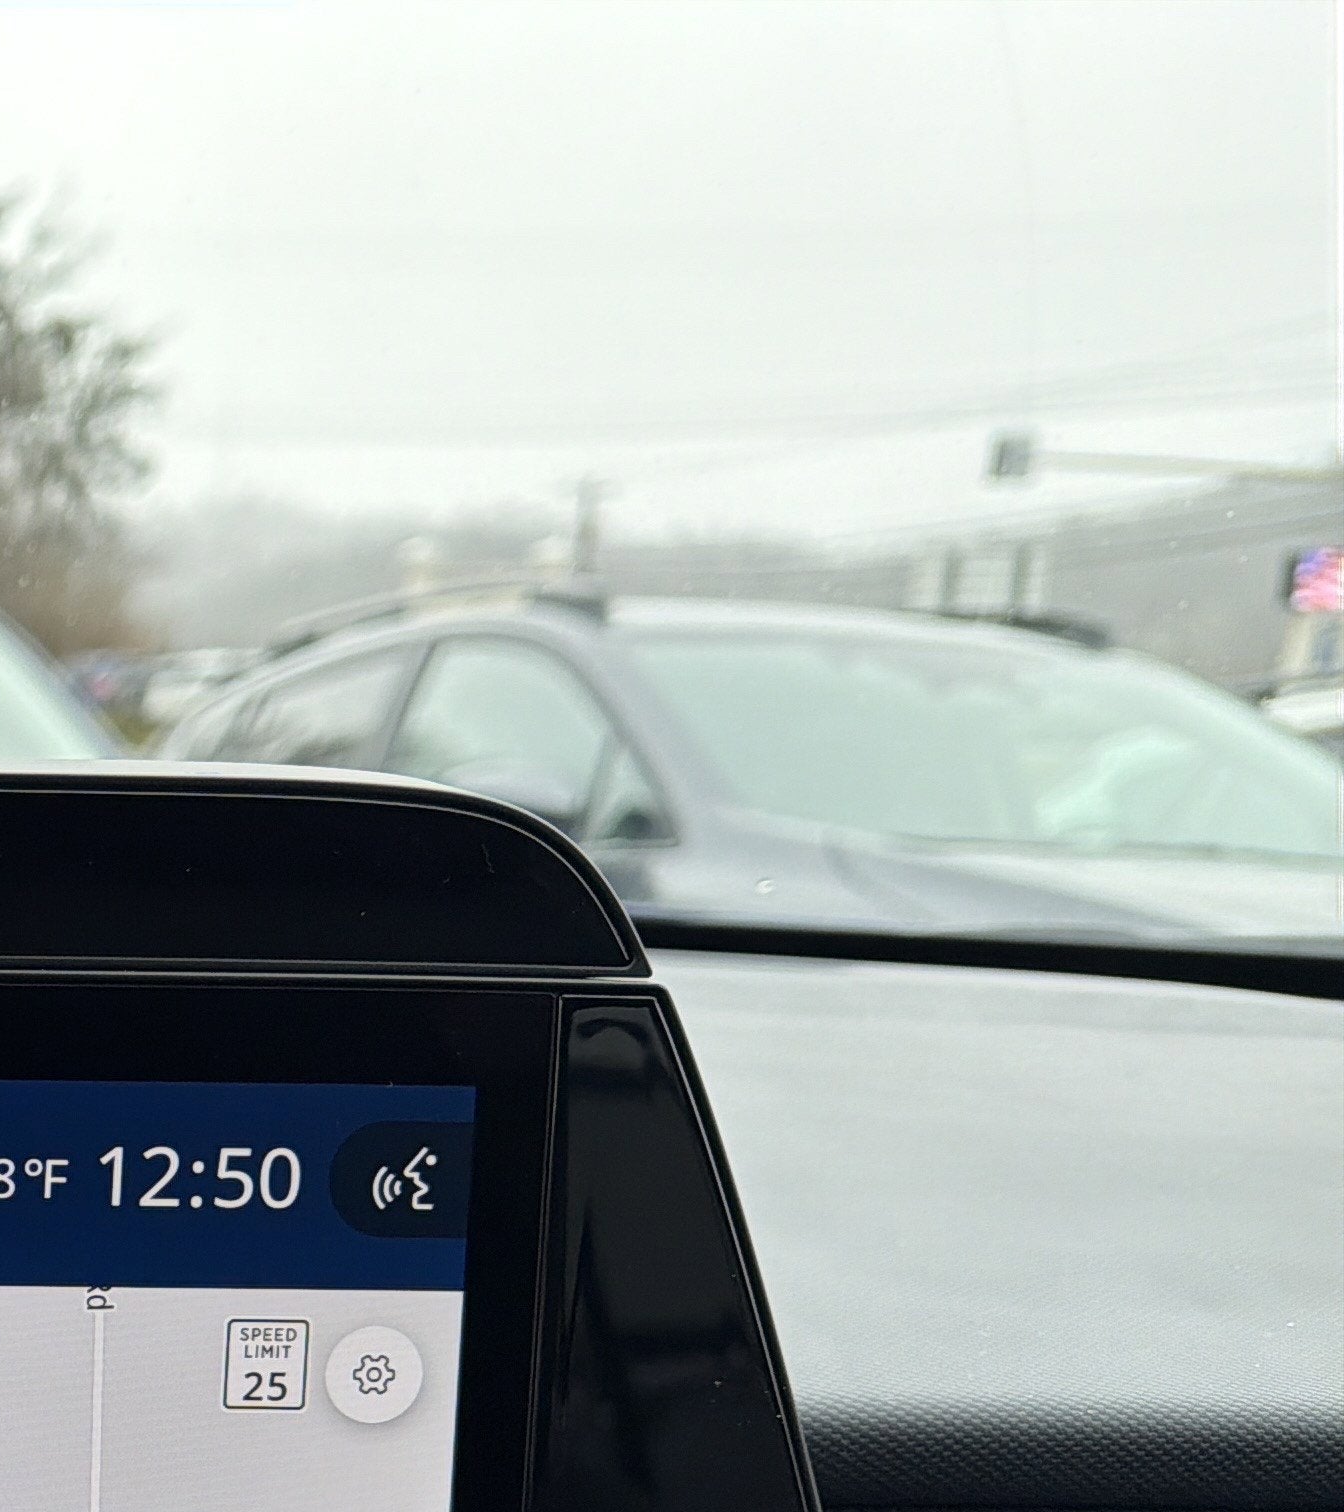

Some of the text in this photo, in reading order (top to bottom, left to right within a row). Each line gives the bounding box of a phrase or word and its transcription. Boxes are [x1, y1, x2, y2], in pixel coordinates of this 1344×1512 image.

[99, 1146, 301, 1210] 12:50
[239, 1327, 298, 1343] SPEED
[244, 1344, 292, 1359] LIMIT
[242, 1371, 288, 1402] 25
